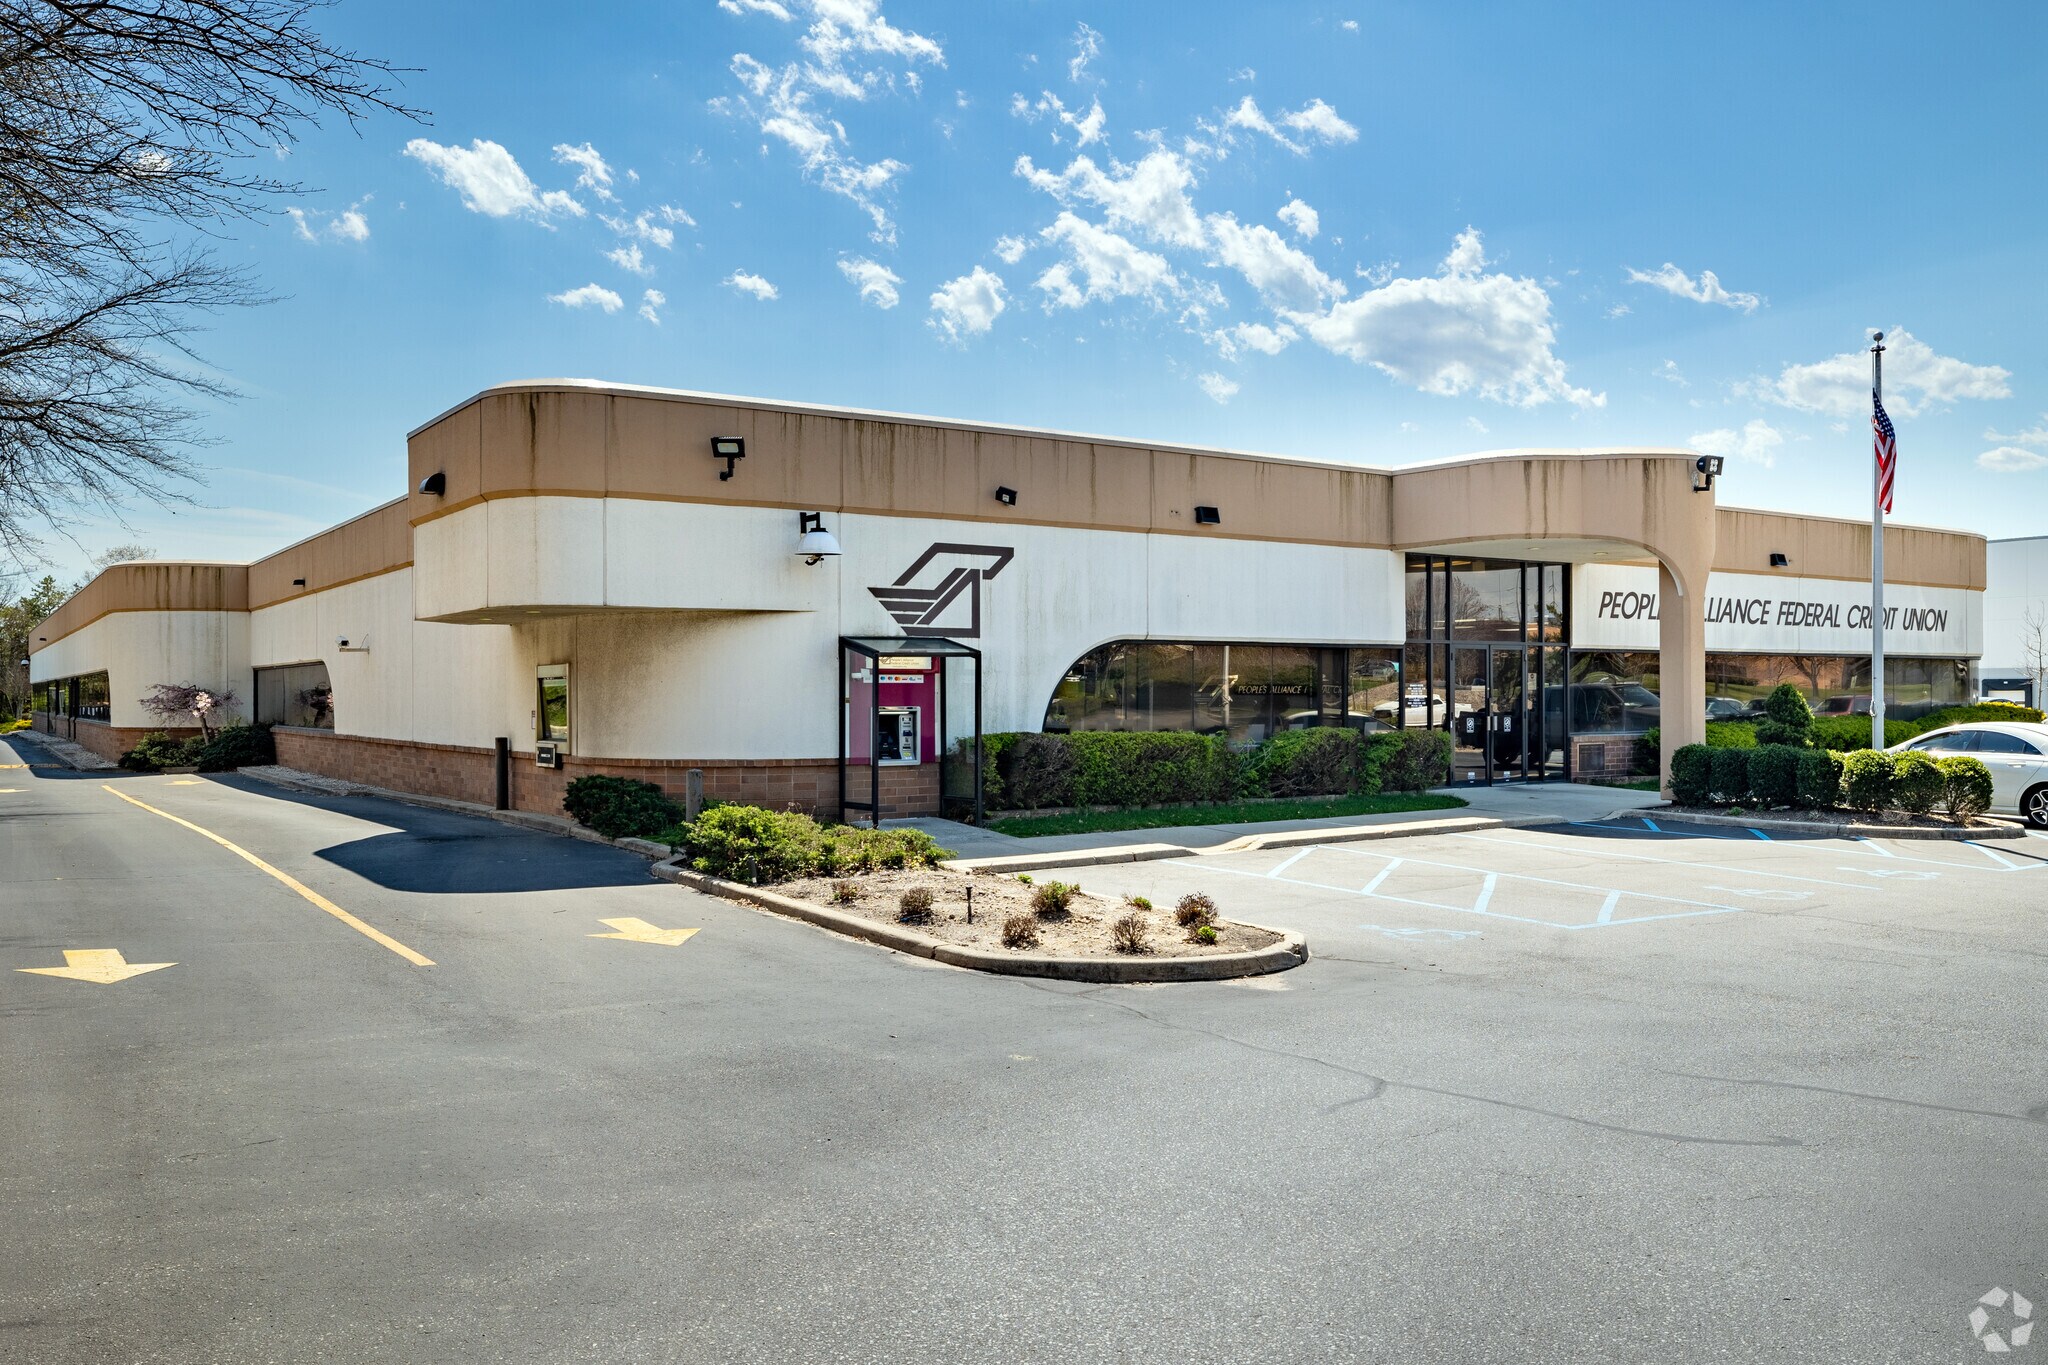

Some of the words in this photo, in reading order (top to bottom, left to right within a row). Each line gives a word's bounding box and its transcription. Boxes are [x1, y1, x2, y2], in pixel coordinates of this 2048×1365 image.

[1598, 591, 1660, 620] PEOPL
[1704, 597, 1772, 625] LIANCE
[1776, 600, 1841, 628] FEDERAL
[1902, 607, 1948, 632] UNION
